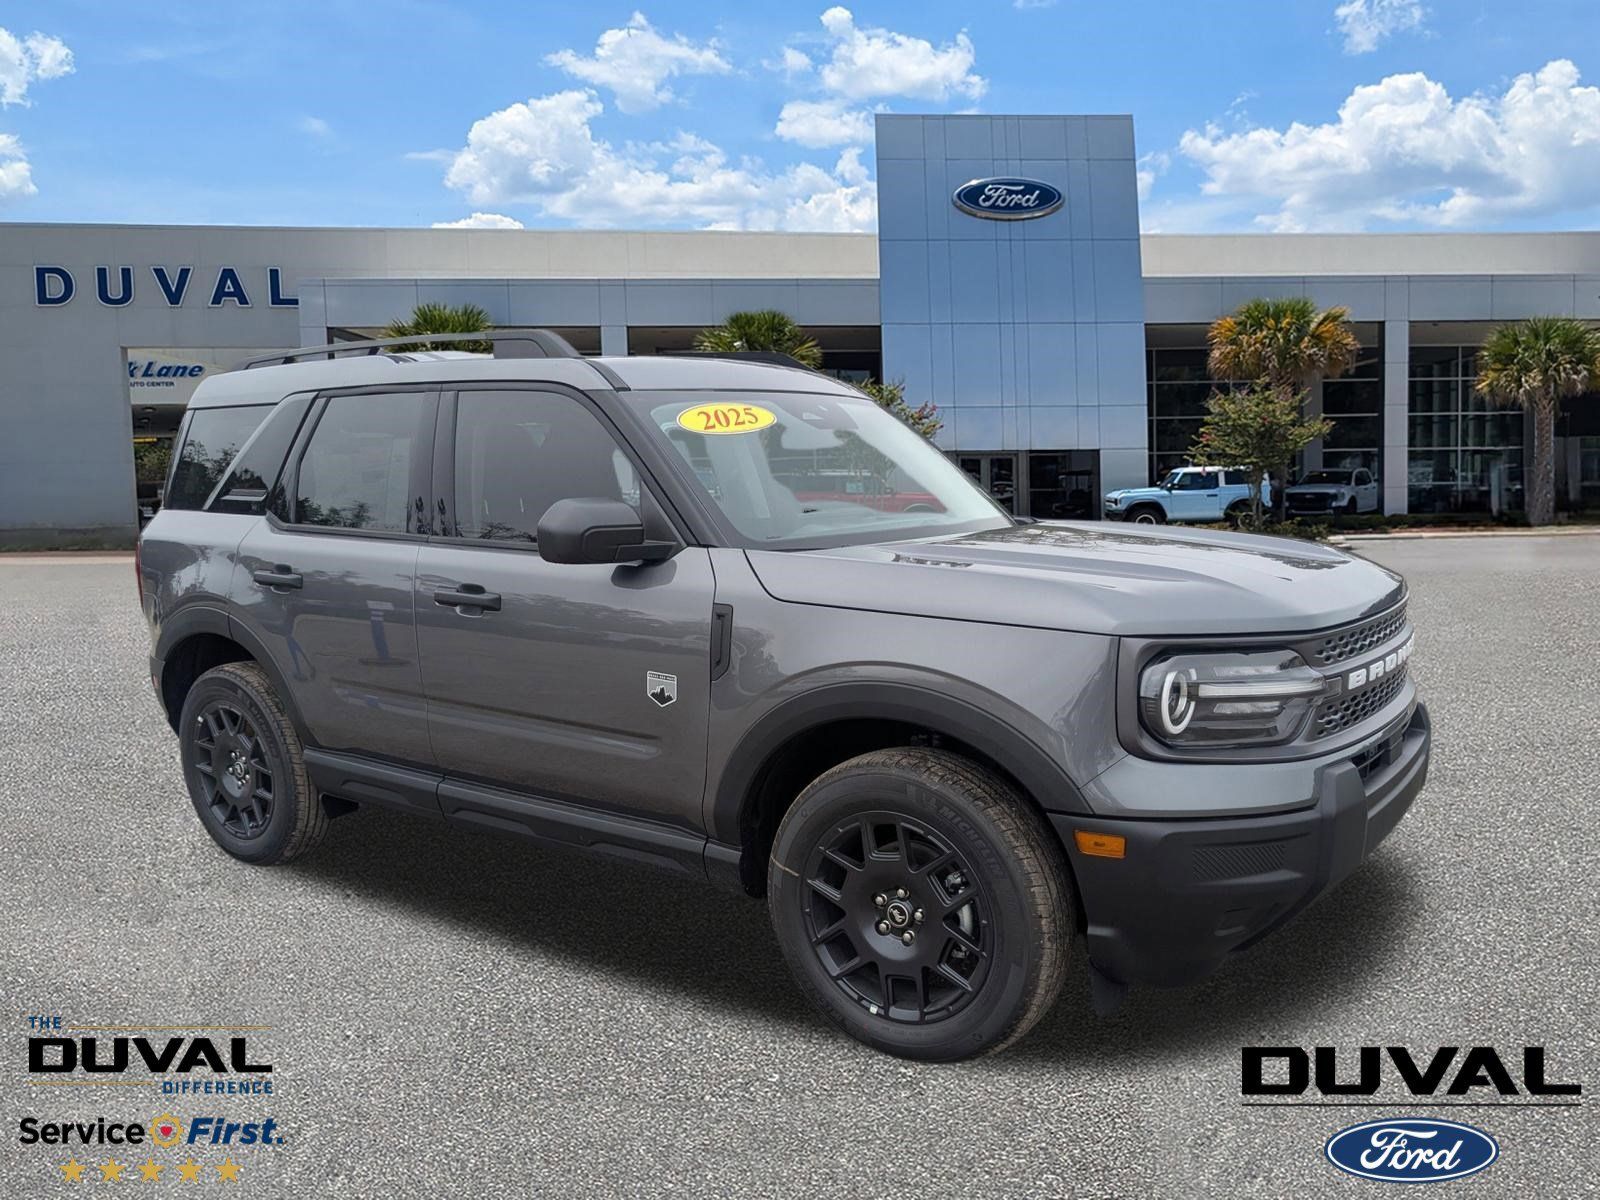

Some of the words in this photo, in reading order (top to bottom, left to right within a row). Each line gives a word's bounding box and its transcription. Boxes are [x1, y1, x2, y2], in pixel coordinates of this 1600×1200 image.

[979, 184, 1040, 207] Ford
[33, 265, 299, 308] DUVAL
[141, 361, 205, 378] Lane
[697, 407, 759, 431] 2025
[1347, 632, 1415, 690] BRON
